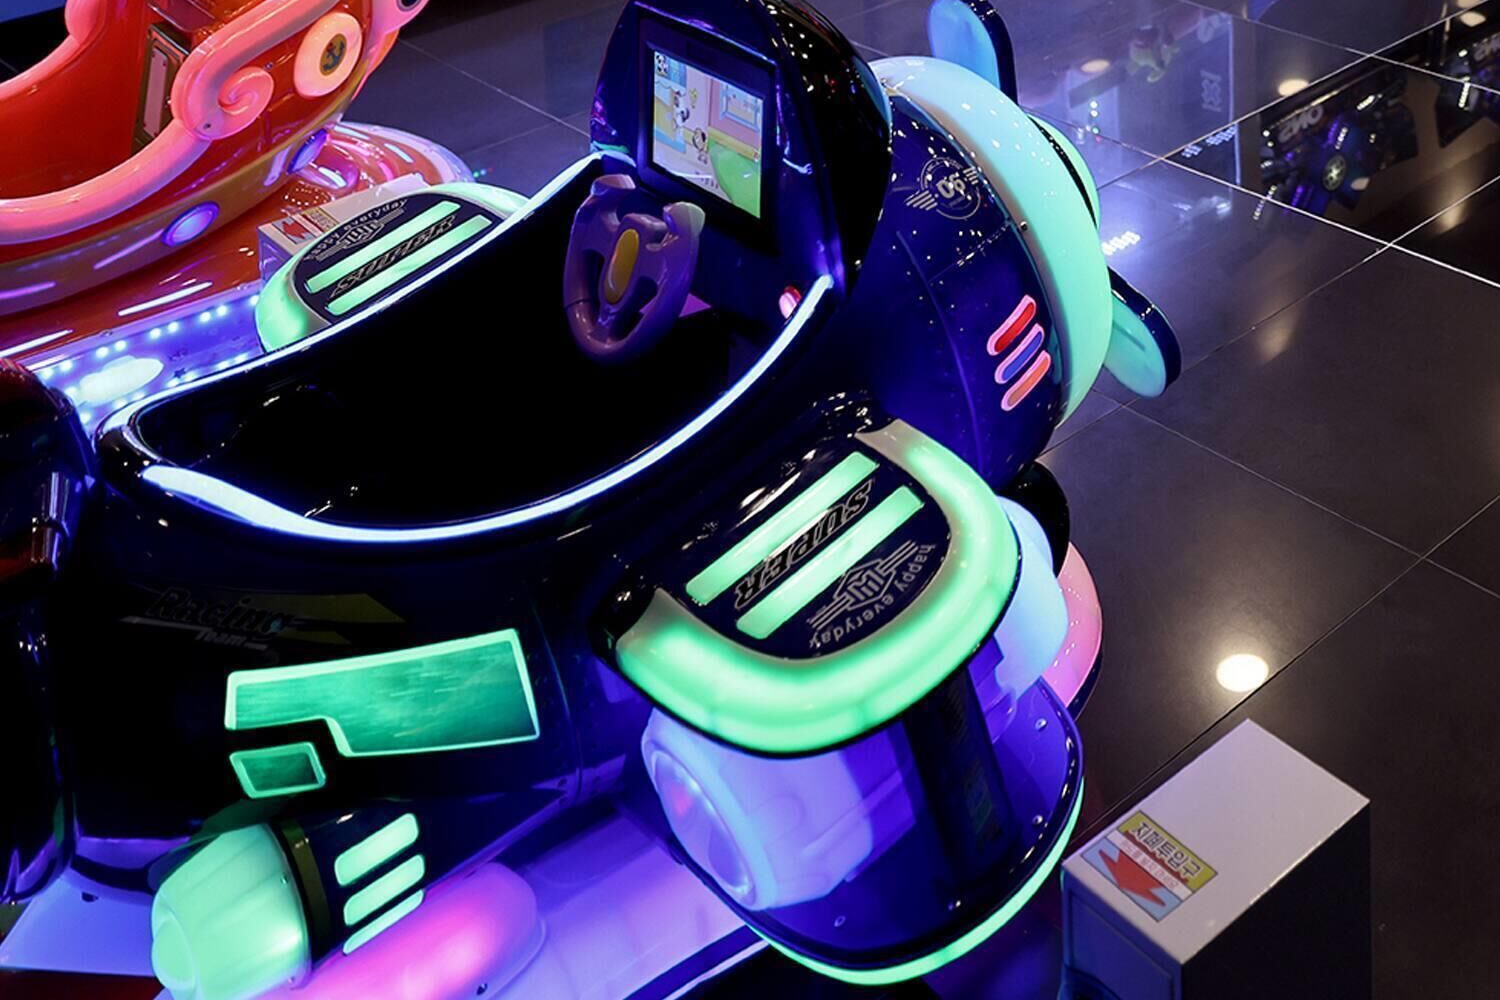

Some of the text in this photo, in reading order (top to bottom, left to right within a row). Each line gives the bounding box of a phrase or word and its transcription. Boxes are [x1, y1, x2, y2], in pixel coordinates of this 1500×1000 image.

[808, 543, 936, 648] happy everyday
[1132, 820, 1202, 877] 지폐투입구
